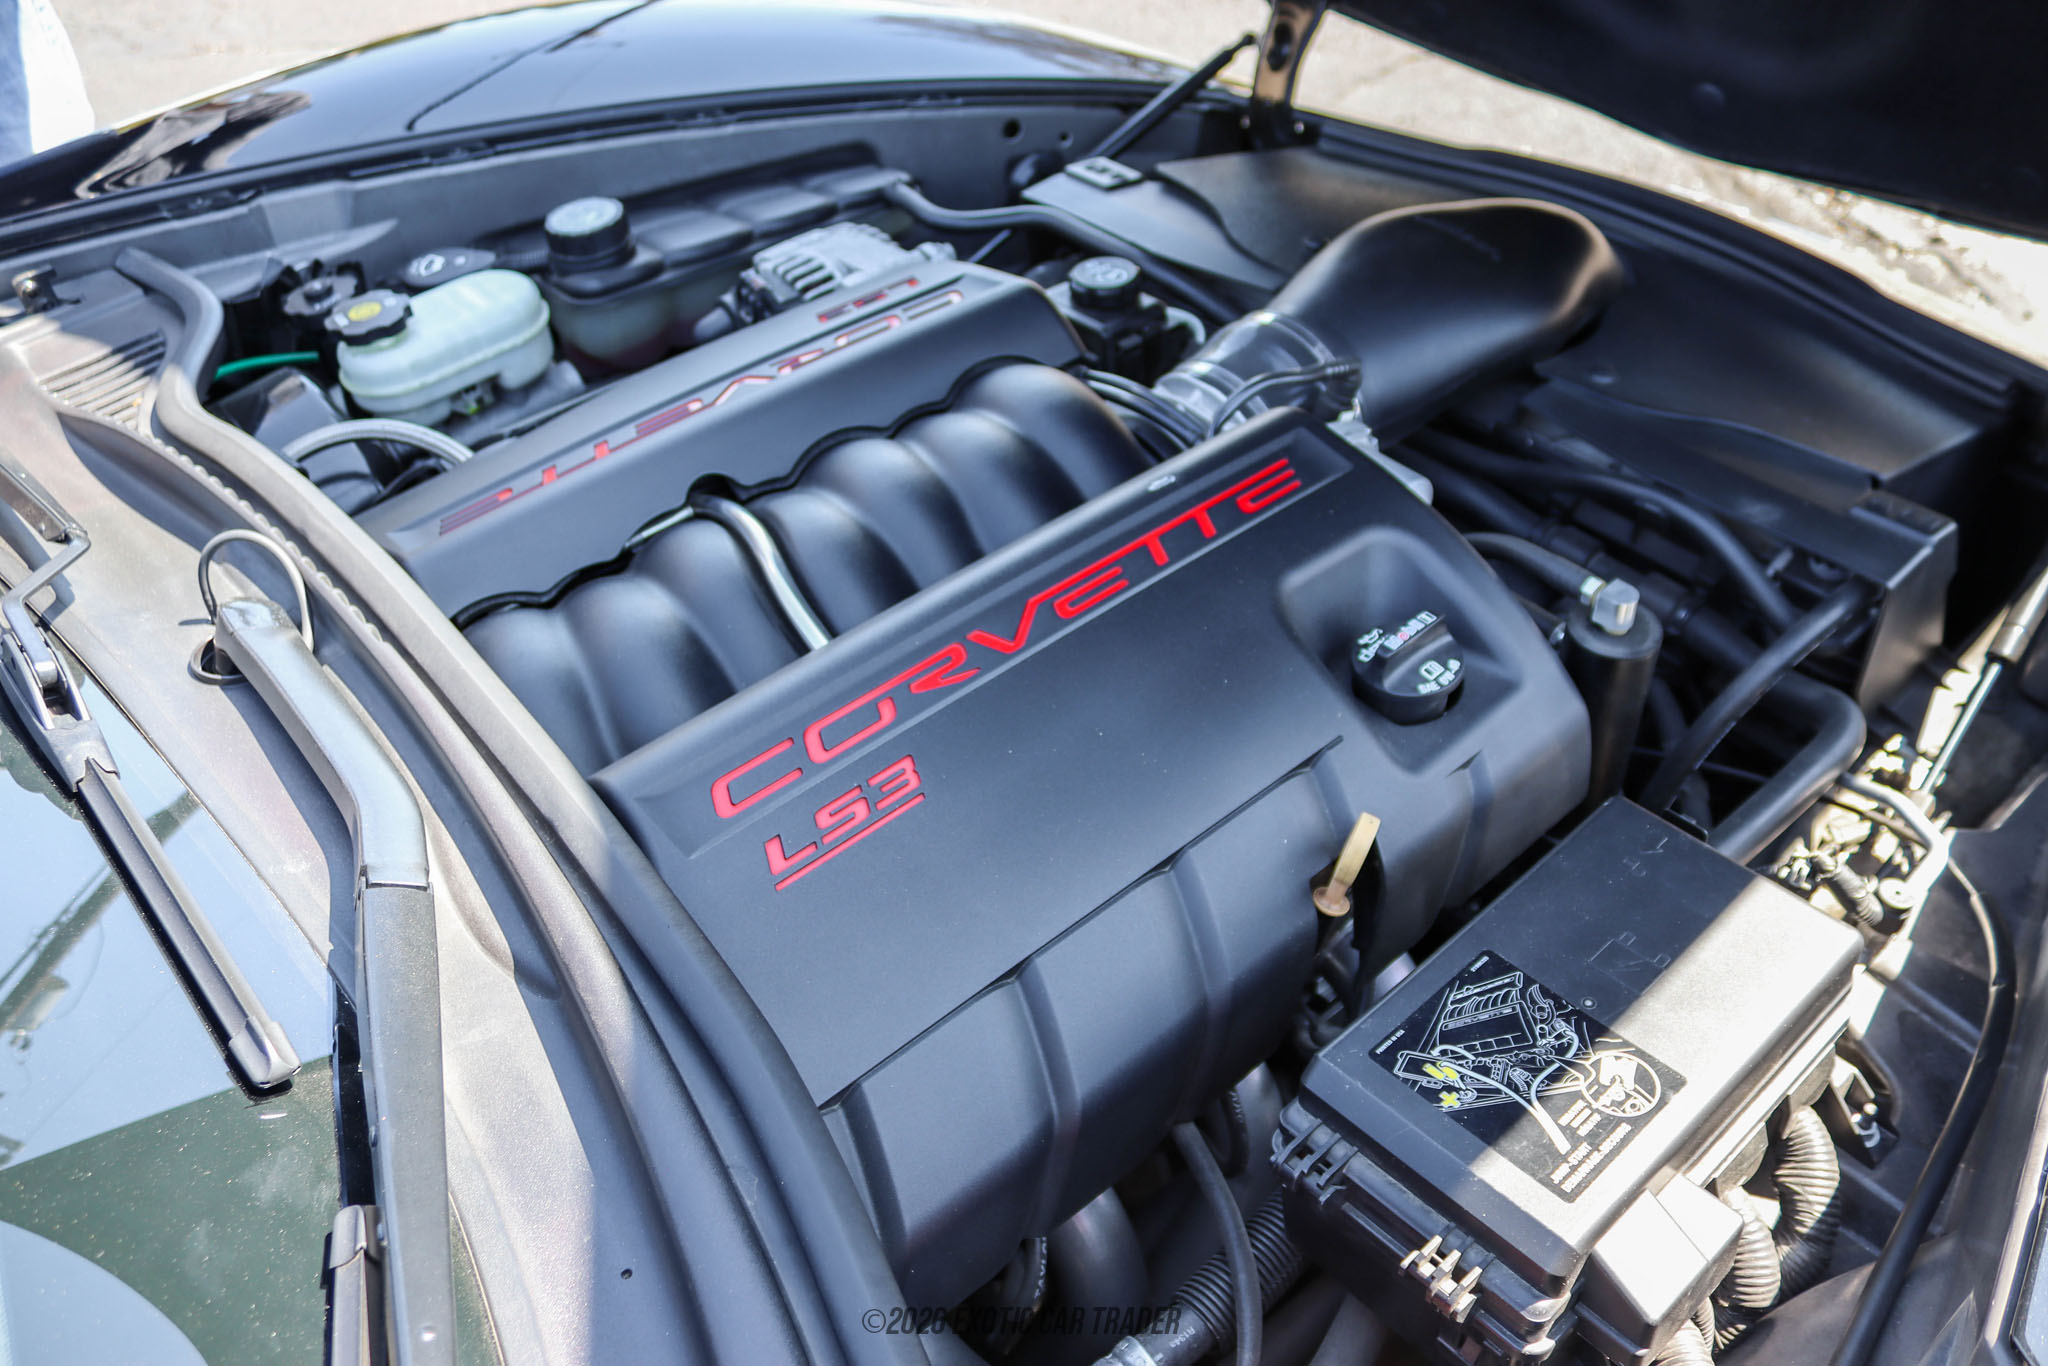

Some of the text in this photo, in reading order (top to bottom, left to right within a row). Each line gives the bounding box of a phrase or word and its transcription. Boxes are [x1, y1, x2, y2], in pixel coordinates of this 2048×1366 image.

[439, 290, 963, 536] CORVETTE
[710, 458, 1301, 819] CORVETTE
[764, 754, 924, 878] LS3
